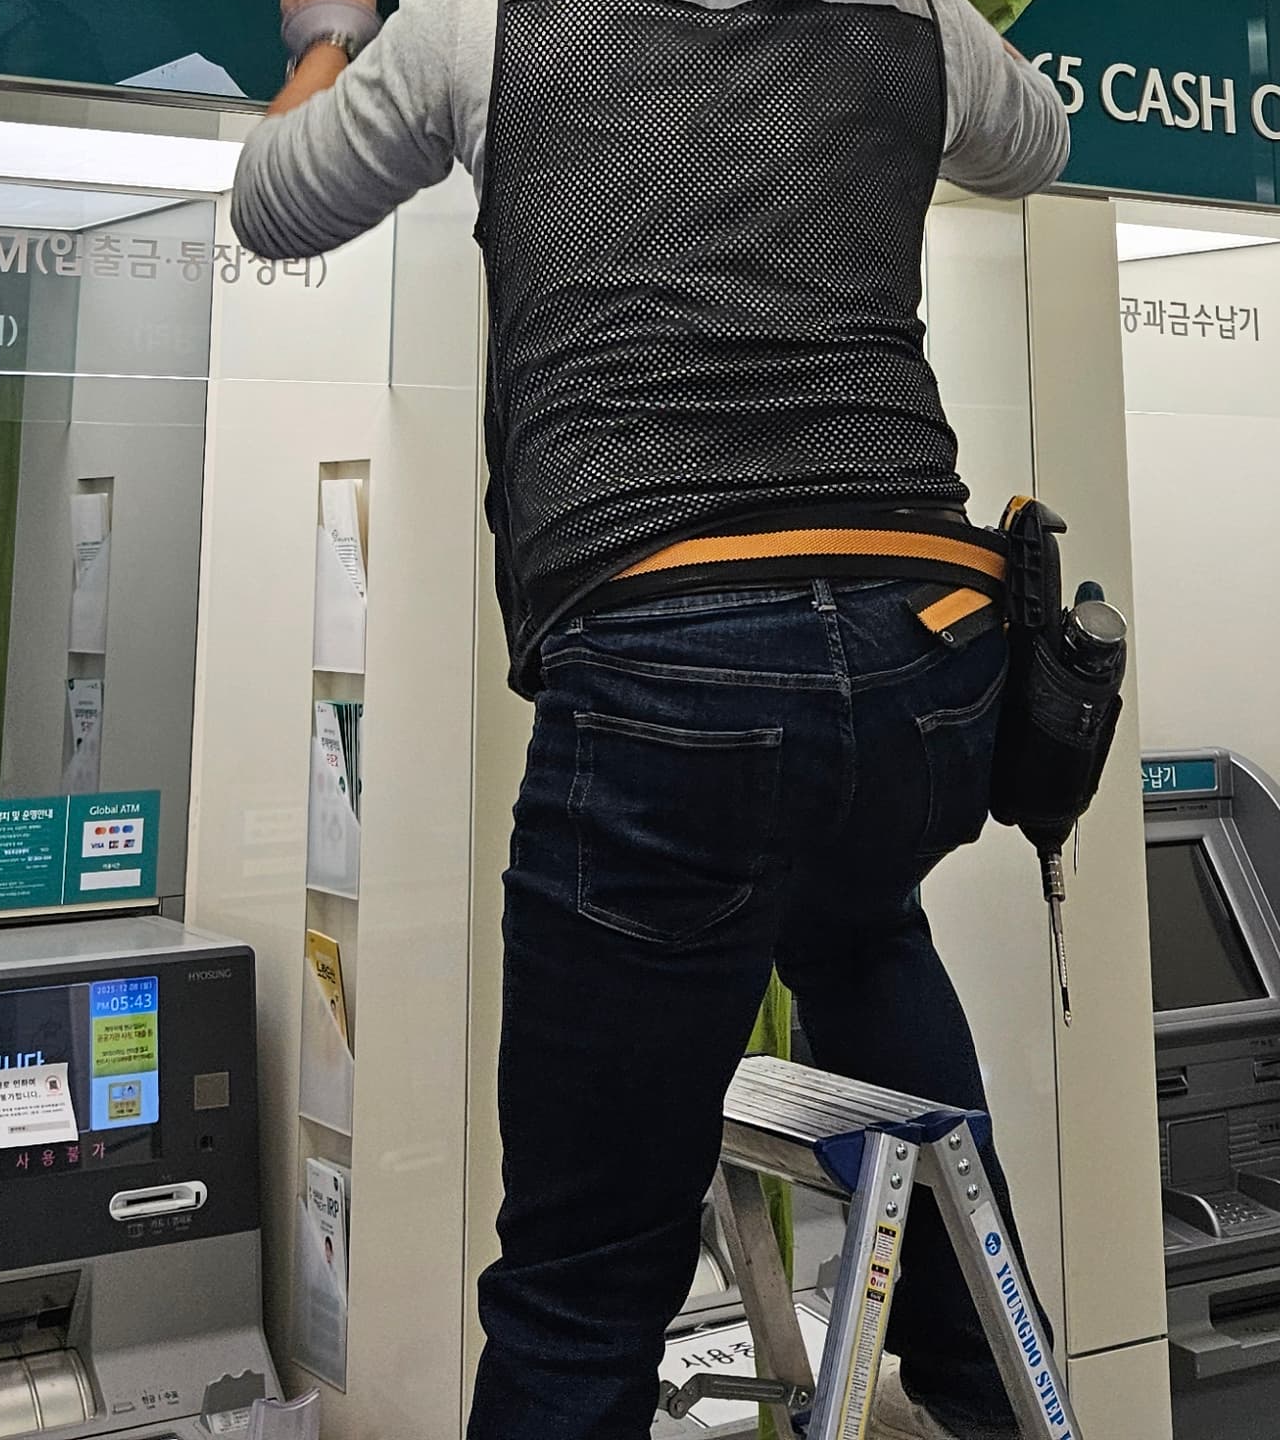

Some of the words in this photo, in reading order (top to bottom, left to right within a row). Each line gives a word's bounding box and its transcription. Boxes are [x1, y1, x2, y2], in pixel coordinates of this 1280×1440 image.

[1100, 63, 1236, 134] CASH
[1120, 297, 1259, 342] 공과금수납기
[89, 804, 119, 816] Global
[120, 803, 140, 813] ATM
[110, 993, 152, 1012] 05:43
[996, 1261, 1042, 1368] YOUNGDO
[1035, 1370, 1065, 1427] STEP
